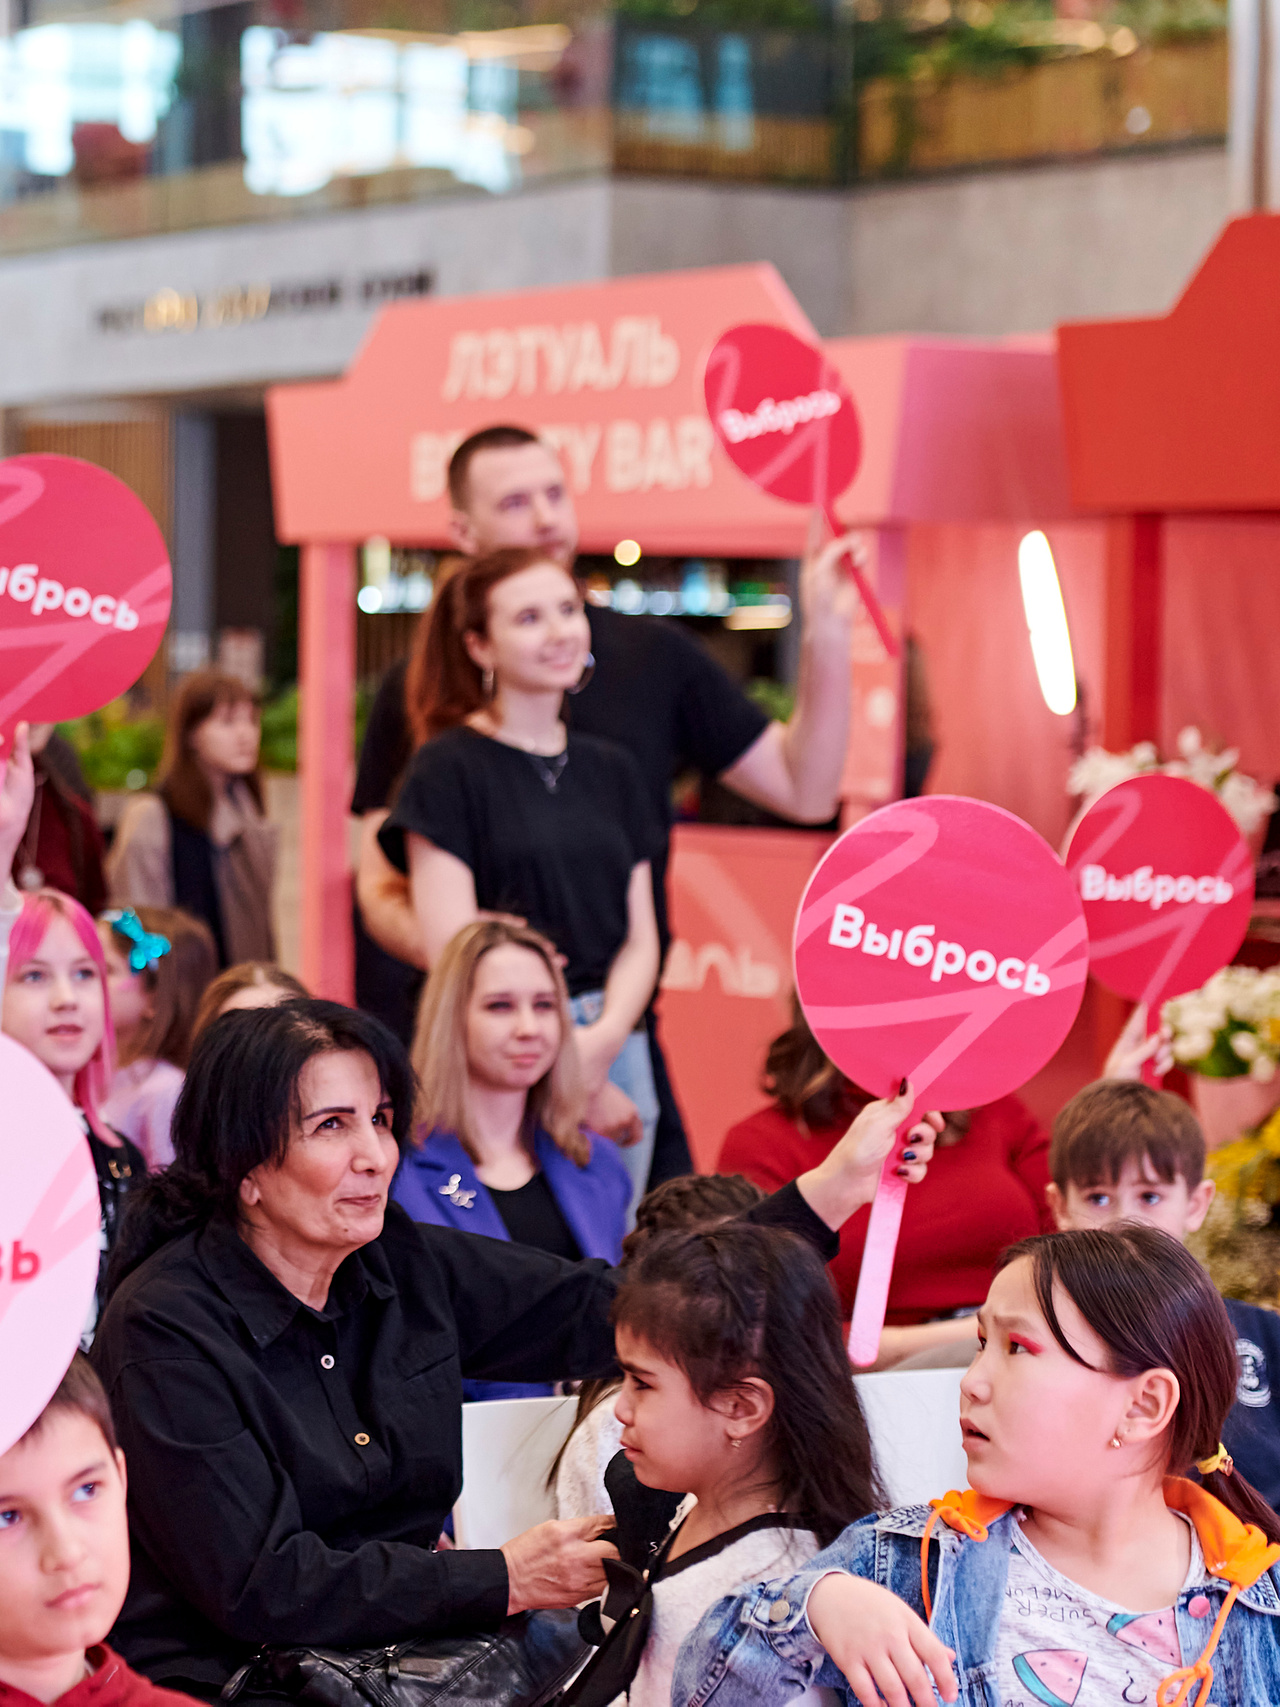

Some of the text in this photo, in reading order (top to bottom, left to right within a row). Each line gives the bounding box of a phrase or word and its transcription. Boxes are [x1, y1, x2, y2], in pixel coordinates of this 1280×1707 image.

[442, 315, 680, 402] ЛЭТУАЛЬ
[720, 388, 841, 443] Выбрось
[605, 413, 714, 494] BAR
[1081, 864, 1233, 909] Выбрось
[828, 903, 1051, 996] Выбрось
[1018, 1599, 1097, 1628] SUPER
